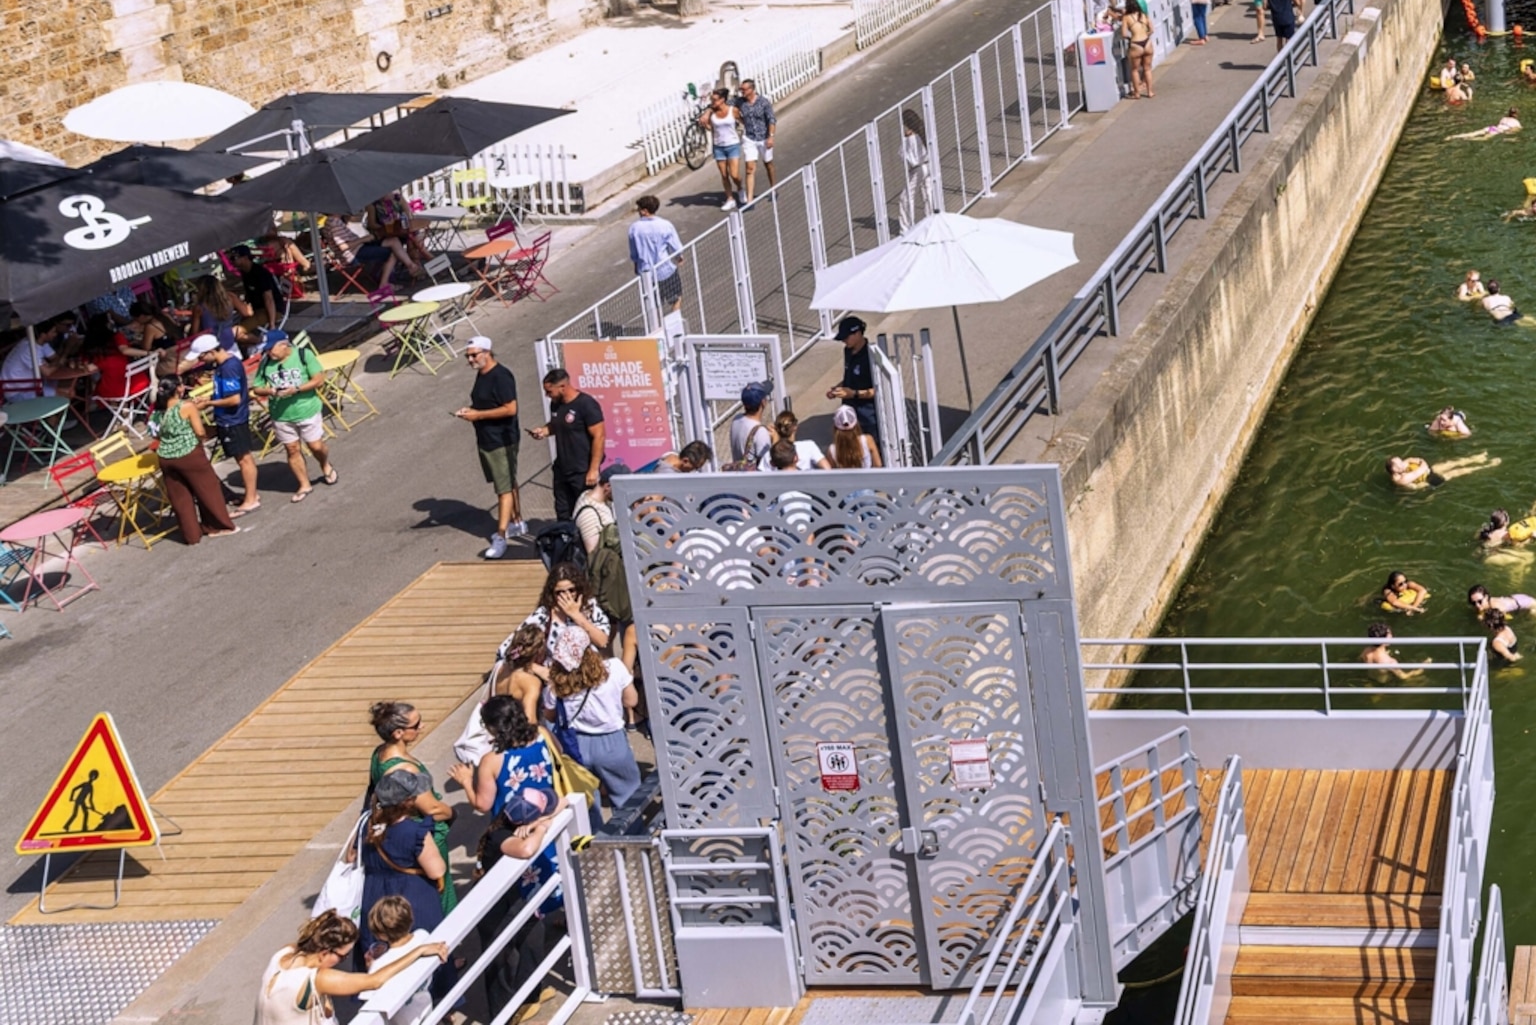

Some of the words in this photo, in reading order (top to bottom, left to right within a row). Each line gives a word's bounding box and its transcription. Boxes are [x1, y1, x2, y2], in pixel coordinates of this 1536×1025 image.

[496, 158, 506, 171] 2
[58, 194, 152, 250] B
[109, 254, 153, 283] BROOKLYN
[152, 241, 190, 267] BREWERY
[582, 361, 644, 376] BAIGNADE
[578, 373, 653, 388] BRAS-MARIE
